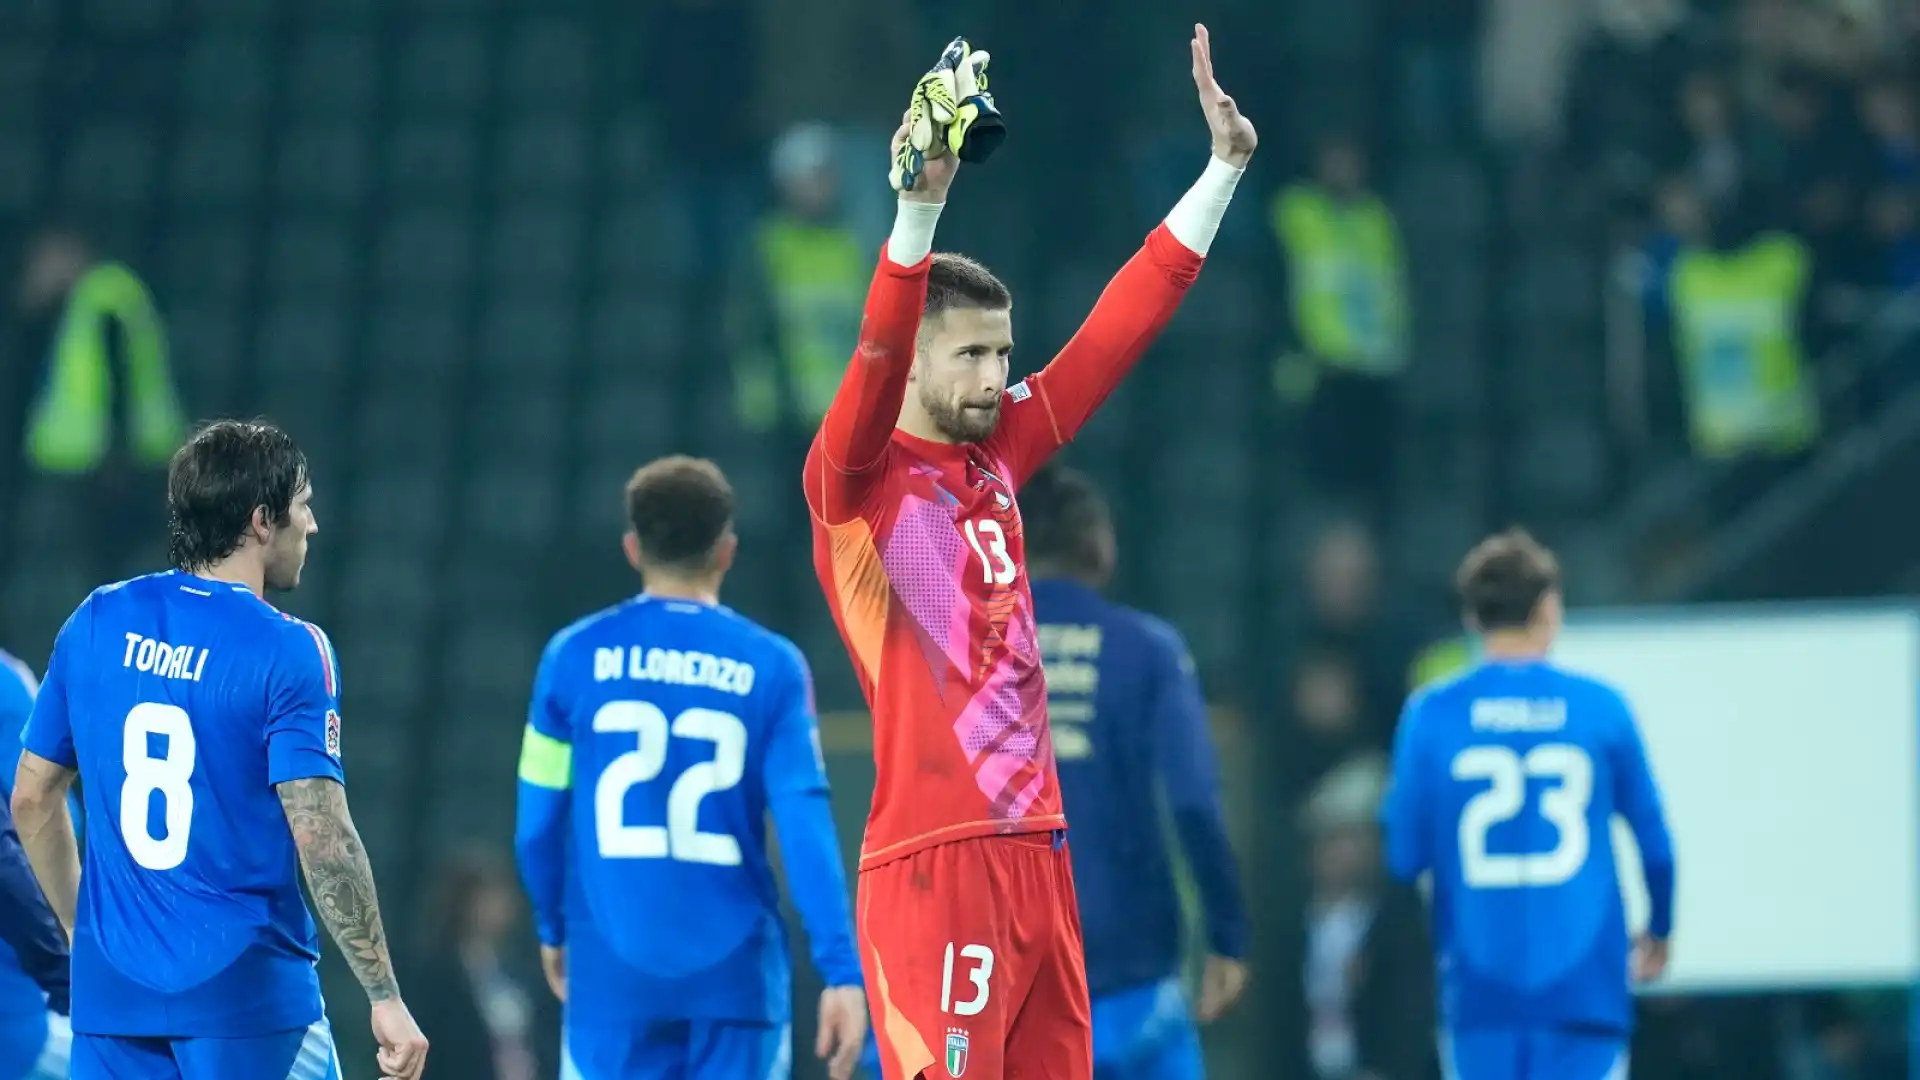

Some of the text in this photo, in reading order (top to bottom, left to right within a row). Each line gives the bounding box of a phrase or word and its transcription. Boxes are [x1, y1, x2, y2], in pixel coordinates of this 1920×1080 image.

[965, 519, 1016, 584] 13
[123, 632, 209, 682] TONALI
[594, 644, 755, 696] DI LORENZO
[120, 702, 195, 870] 8
[593, 699, 746, 866] 22
[1452, 743, 1593, 887] 23
[941, 941, 994, 1016] 13
